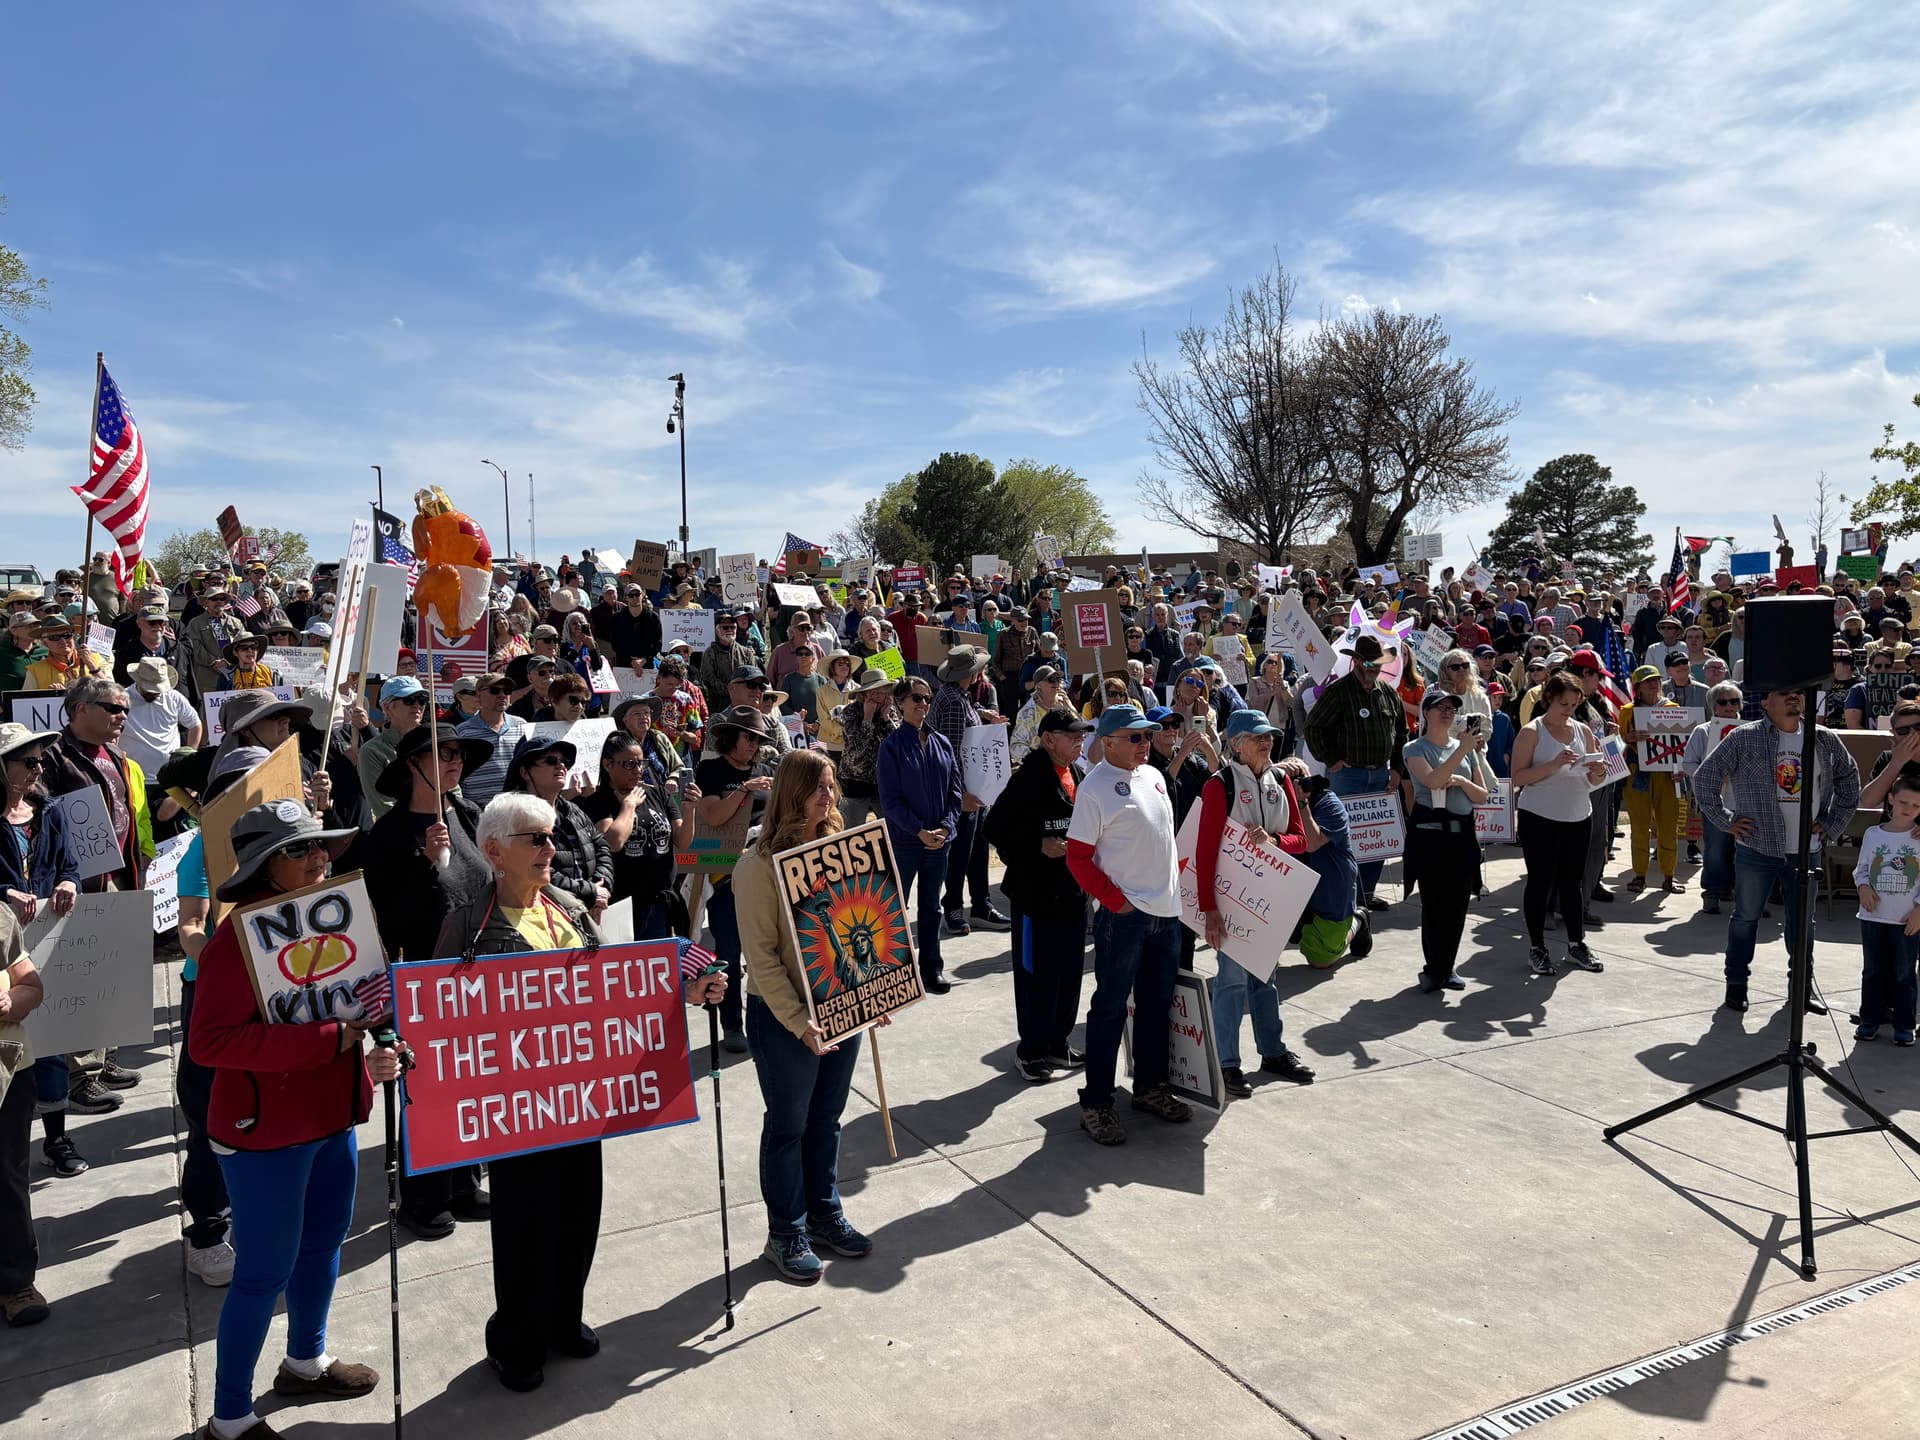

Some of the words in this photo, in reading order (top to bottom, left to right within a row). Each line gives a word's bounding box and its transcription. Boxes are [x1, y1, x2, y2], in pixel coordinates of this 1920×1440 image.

[378, 520, 392, 536] NO
[743, 573, 757, 582] NO
[673, 624, 703, 636] Insanity
[992, 740, 1004, 781] Restore
[1379, 799, 1388, 807] IS
[1349, 810, 1396, 823] MPLIANCE
[71, 824, 109, 845] NGS
[1350, 830, 1368, 840] and
[1370, 829, 1382, 839] Up
[1490, 824, 1504, 833] Up
[1222, 825, 1238, 841] TE
[1238, 830, 1293, 876] DEMOCRAT
[1359, 841, 1385, 853] Speak
[1387, 838, 1399, 848] Up
[782, 827, 886, 904] RESIST
[1222, 843, 1264, 878] 2026
[1238, 886, 1271, 919] Left
[250, 889, 354, 954] NO
[47, 935, 98, 950] Trump
[54, 961, 74, 972] to
[80, 960, 98, 976] go
[406, 981, 424, 1023] I
[436, 974, 488, 1019] AM
[498, 965, 594, 1013] HERE
[602, 956, 673, 1000] FOR
[817, 989, 857, 1019] DEFEND
[856, 963, 914, 1002] DEMOCRACY
[37, 993, 87, 1016] Kings
[820, 1005, 861, 1040] FIGHT
[863, 978, 920, 1016] FASCISM
[428, 1033, 499, 1082] THE
[510, 1021, 594, 1071] KIDS
[603, 1012, 666, 1058] AND
[457, 1070, 661, 1143] GRANDKIDS
